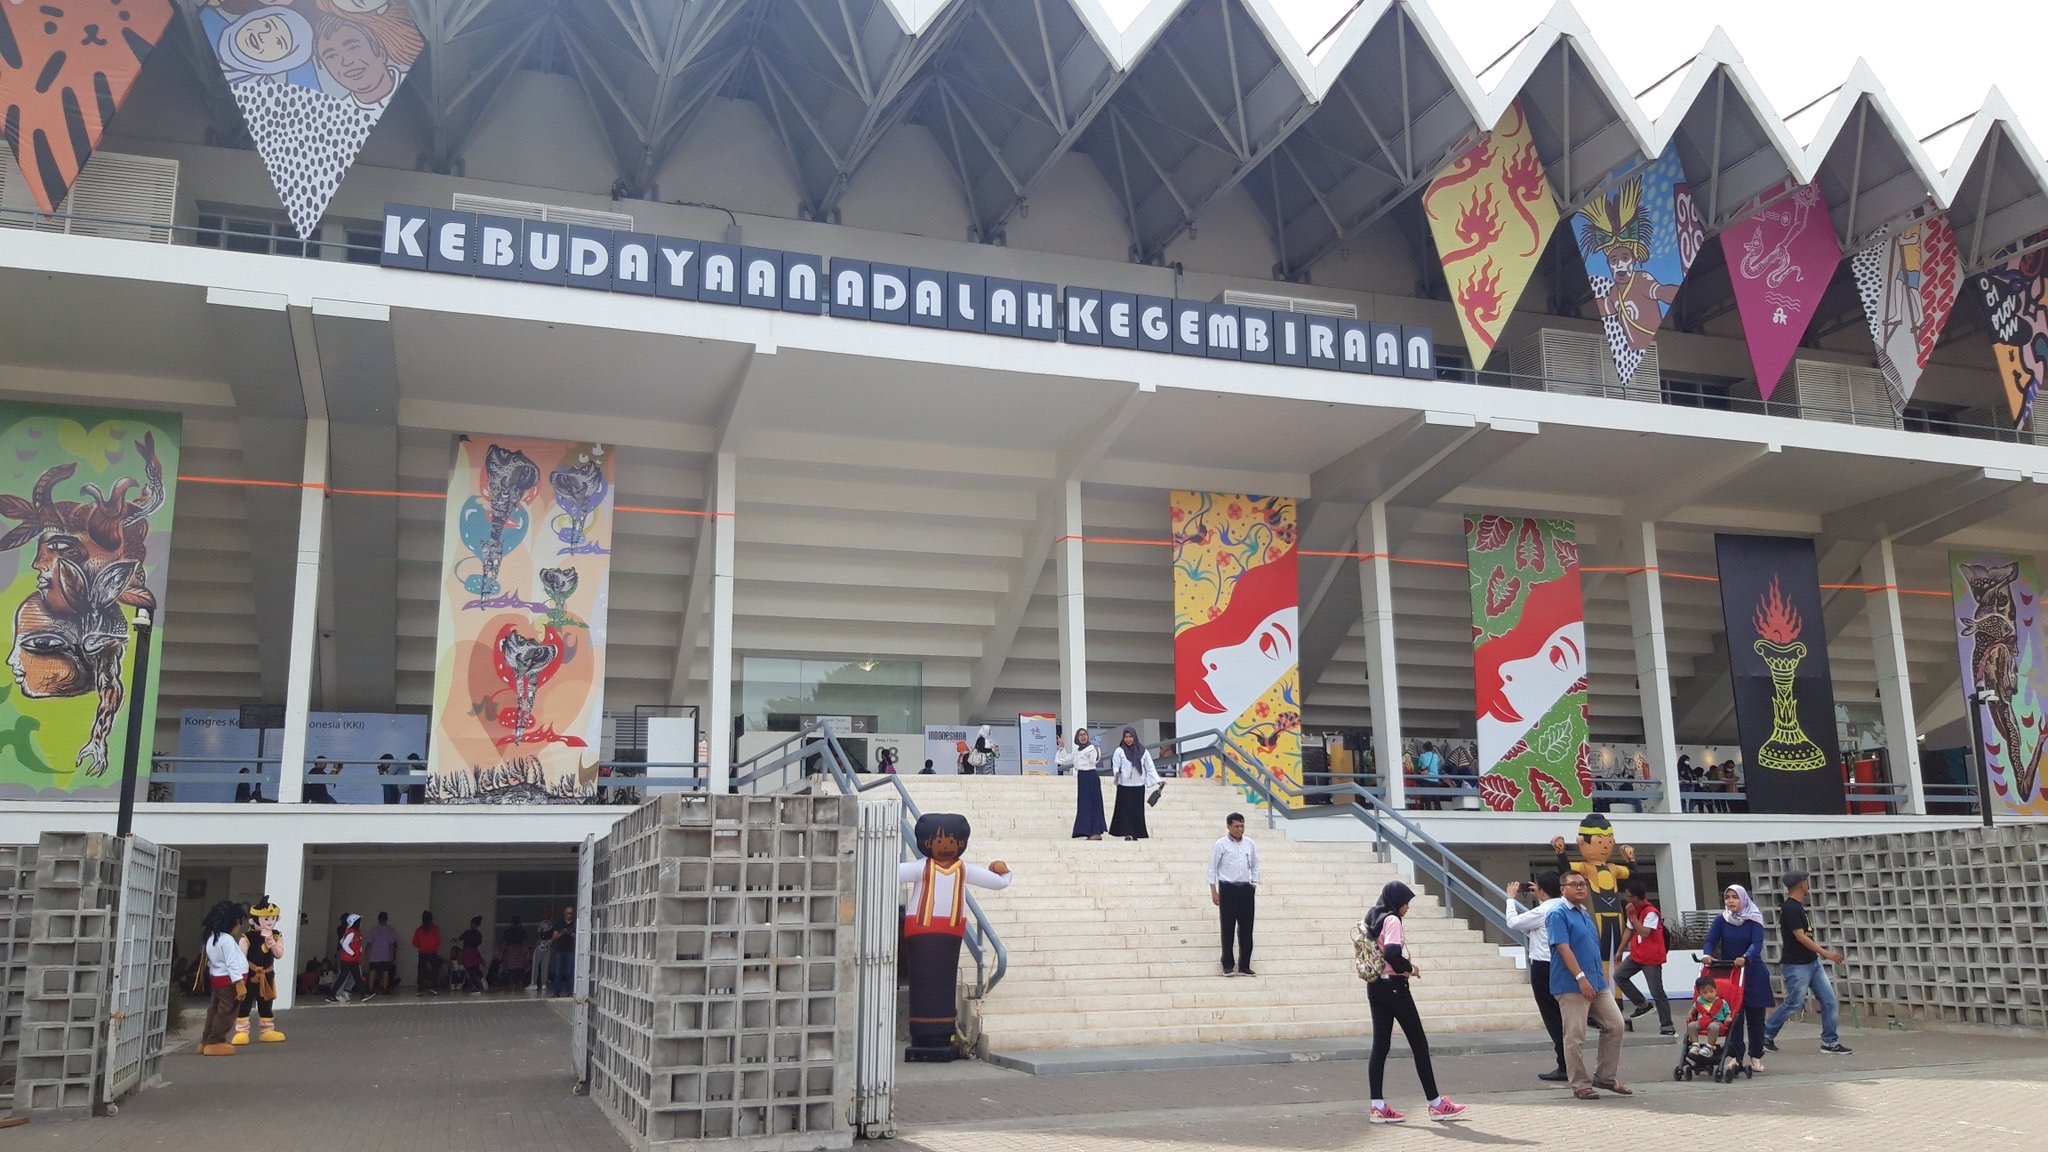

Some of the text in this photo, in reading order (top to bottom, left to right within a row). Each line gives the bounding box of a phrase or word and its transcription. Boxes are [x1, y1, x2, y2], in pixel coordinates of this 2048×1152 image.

[383, 214, 1430, 369] KEBUDAYAAN ADALAH KEGEMBIRAAN
[184, 716, 227, 729] Kongres
[309, 720, 341, 729] onesia
